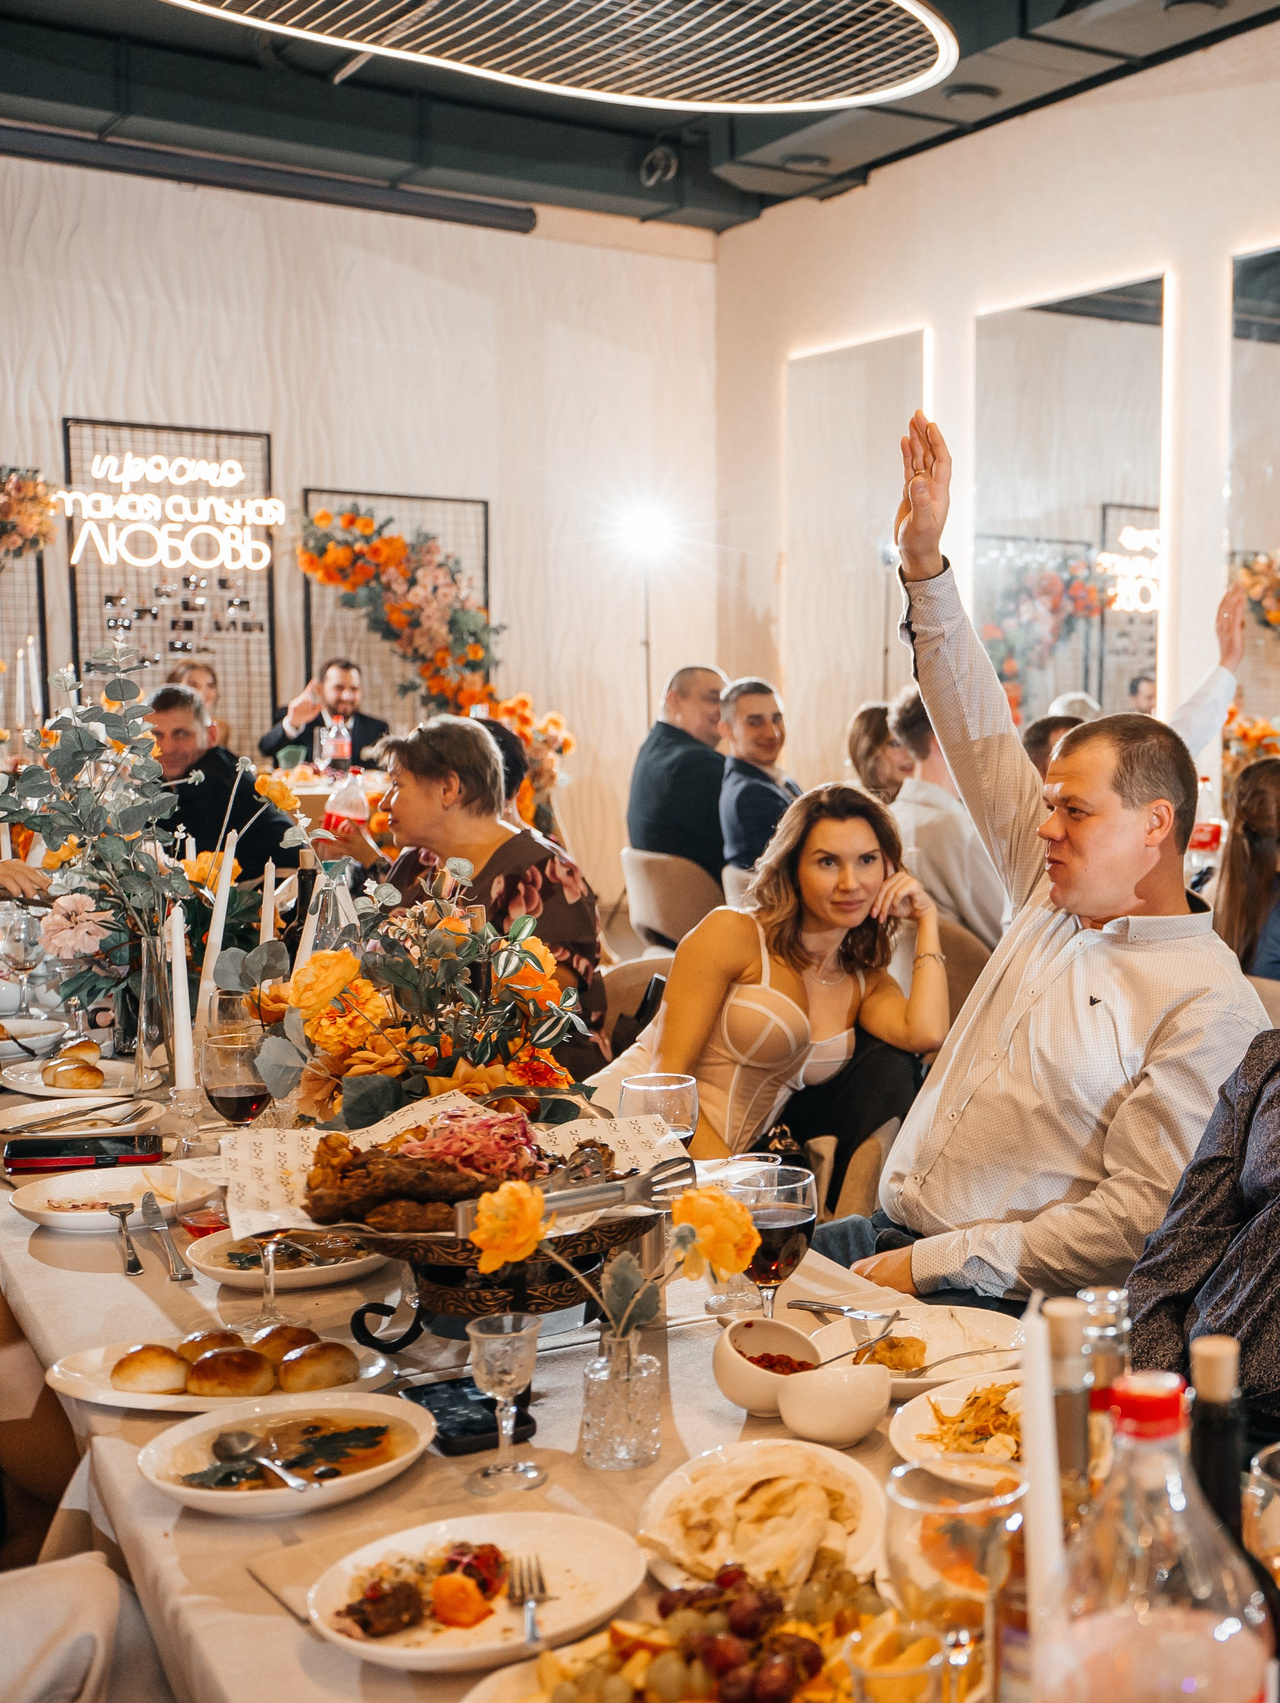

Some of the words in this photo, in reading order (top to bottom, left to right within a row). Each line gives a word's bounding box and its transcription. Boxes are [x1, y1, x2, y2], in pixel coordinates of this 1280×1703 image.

[90, 451, 246, 493] просто
[54, 490, 162, 521] такая
[164, 494, 286, 525] сильная
[70, 520, 272, 571] ЛЮБОВЬ
